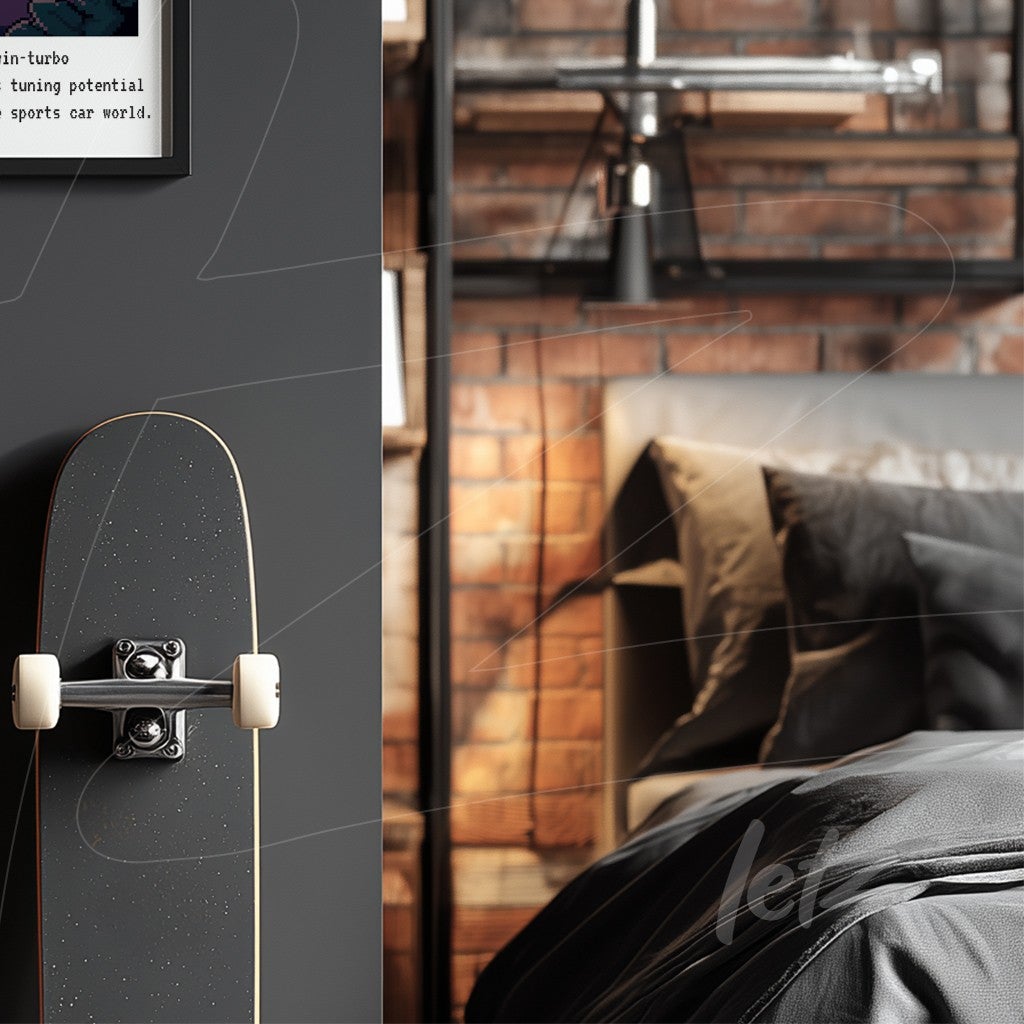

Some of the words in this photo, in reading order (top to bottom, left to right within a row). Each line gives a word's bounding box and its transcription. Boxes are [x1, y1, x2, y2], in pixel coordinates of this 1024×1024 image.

[10, 78, 61, 96] tuning
[69, 77, 144, 96] potential
[10, 105, 61, 123] sports
[69, 108, 95, 119] car
[102, 105, 152, 119] world.
